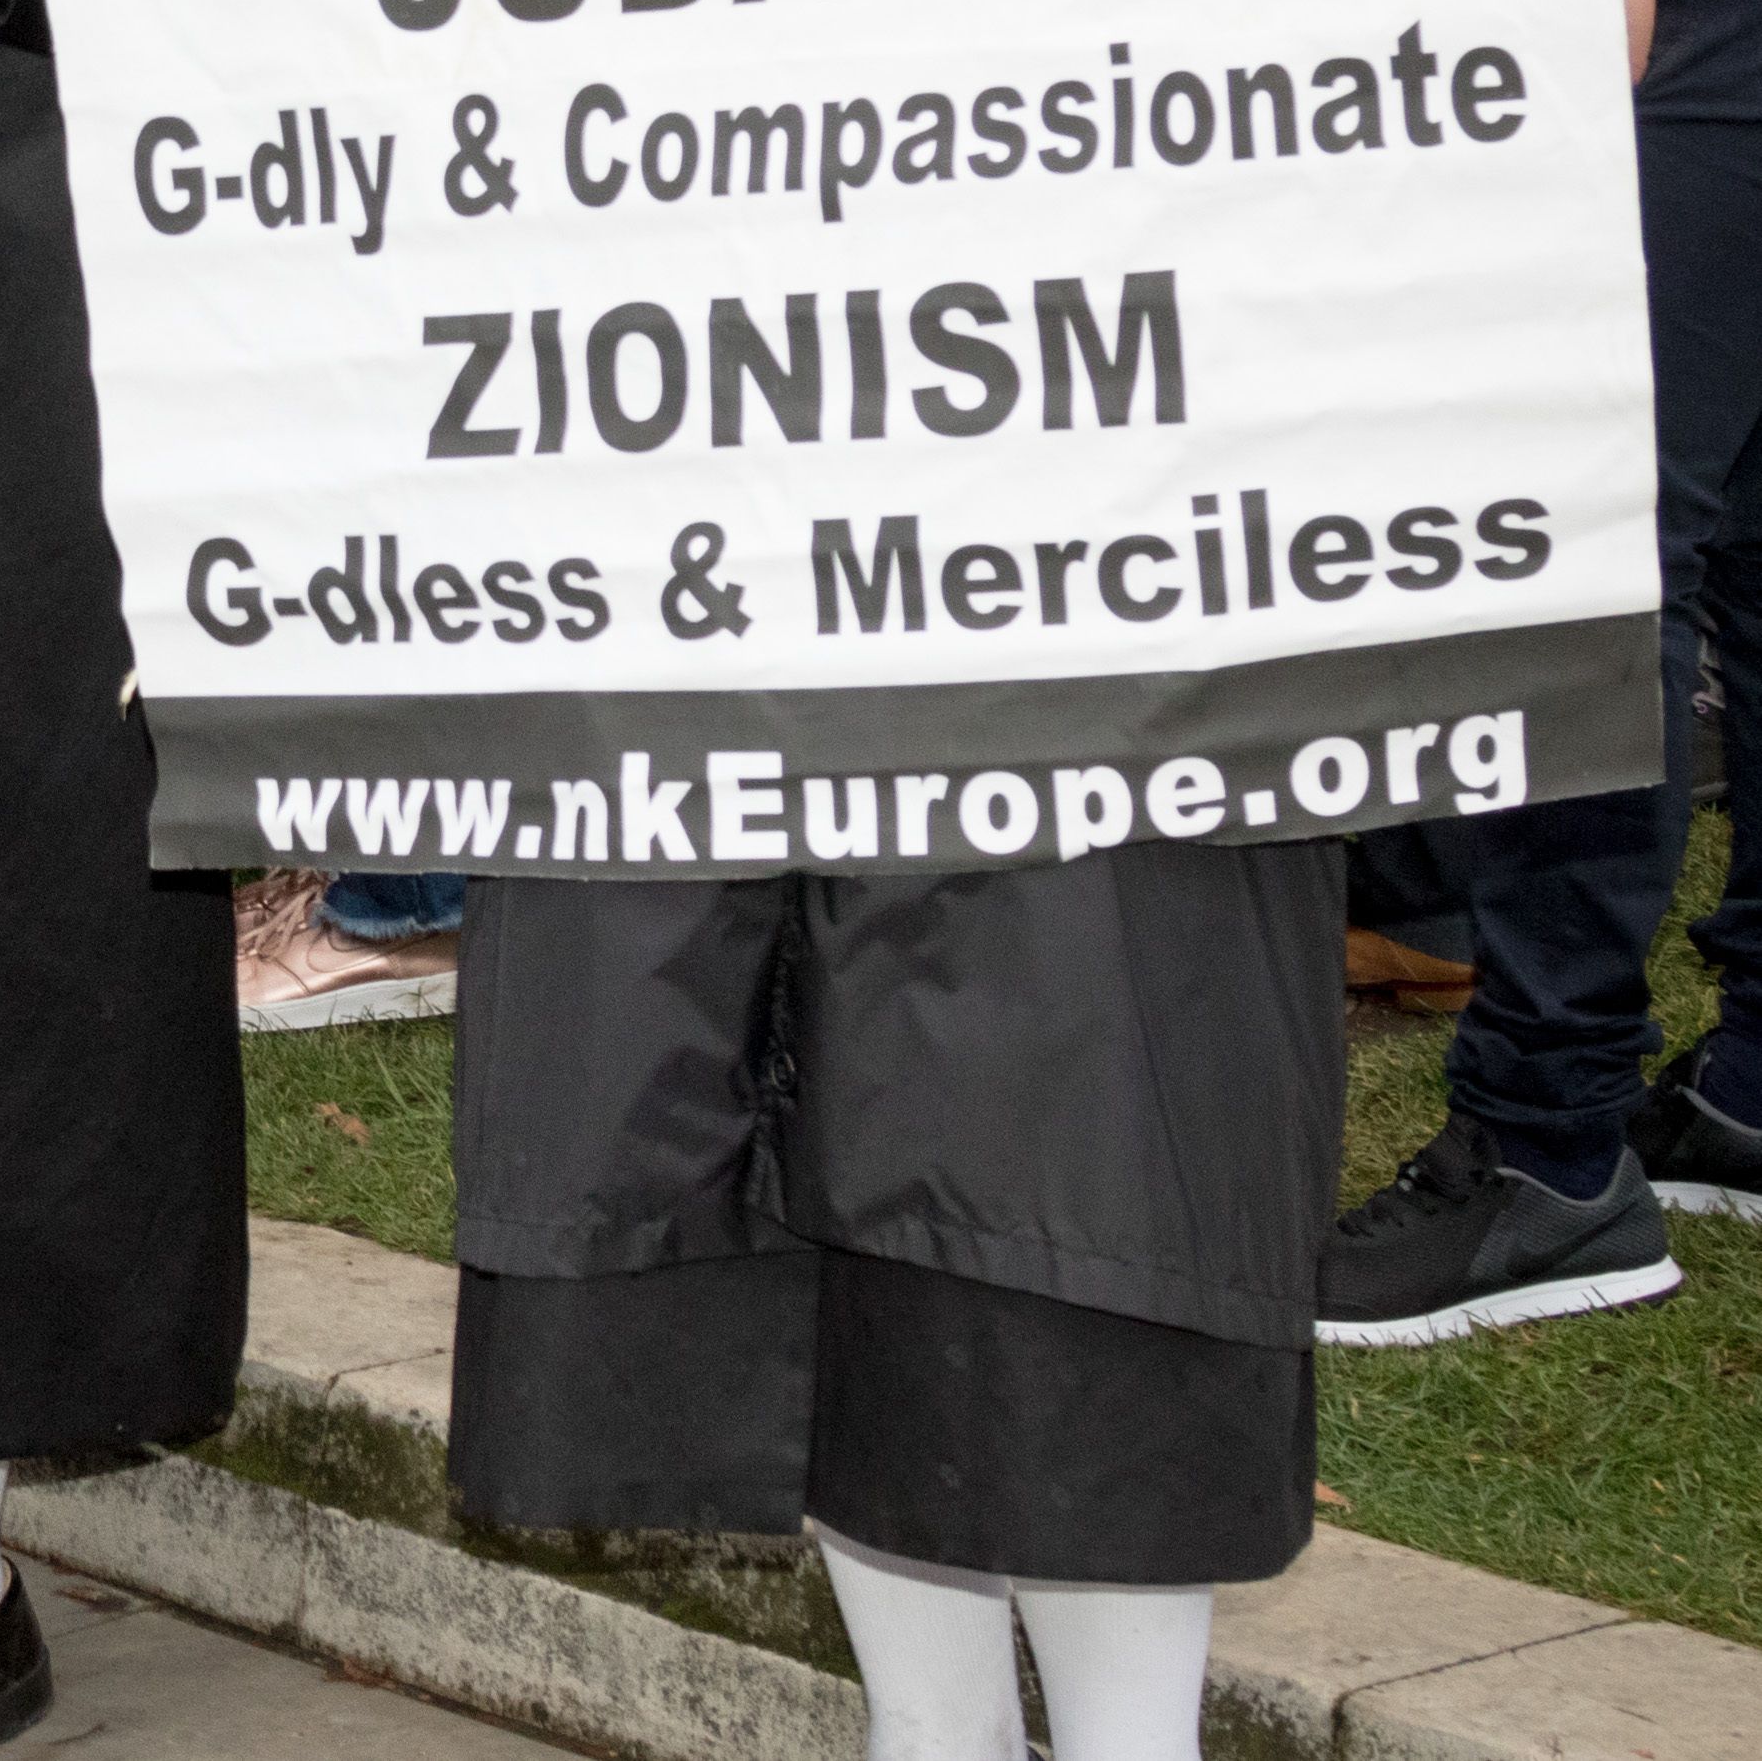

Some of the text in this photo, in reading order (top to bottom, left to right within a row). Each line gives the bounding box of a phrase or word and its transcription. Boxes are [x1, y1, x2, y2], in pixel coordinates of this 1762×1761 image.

[134, 18, 1528, 256] G-dly & Compassionate
[422, 269, 1186, 460] ZIONISM
[186, 488, 1552, 647] G-dless & Merciless
[256, 710, 1529, 863] www.nkEurope.org
